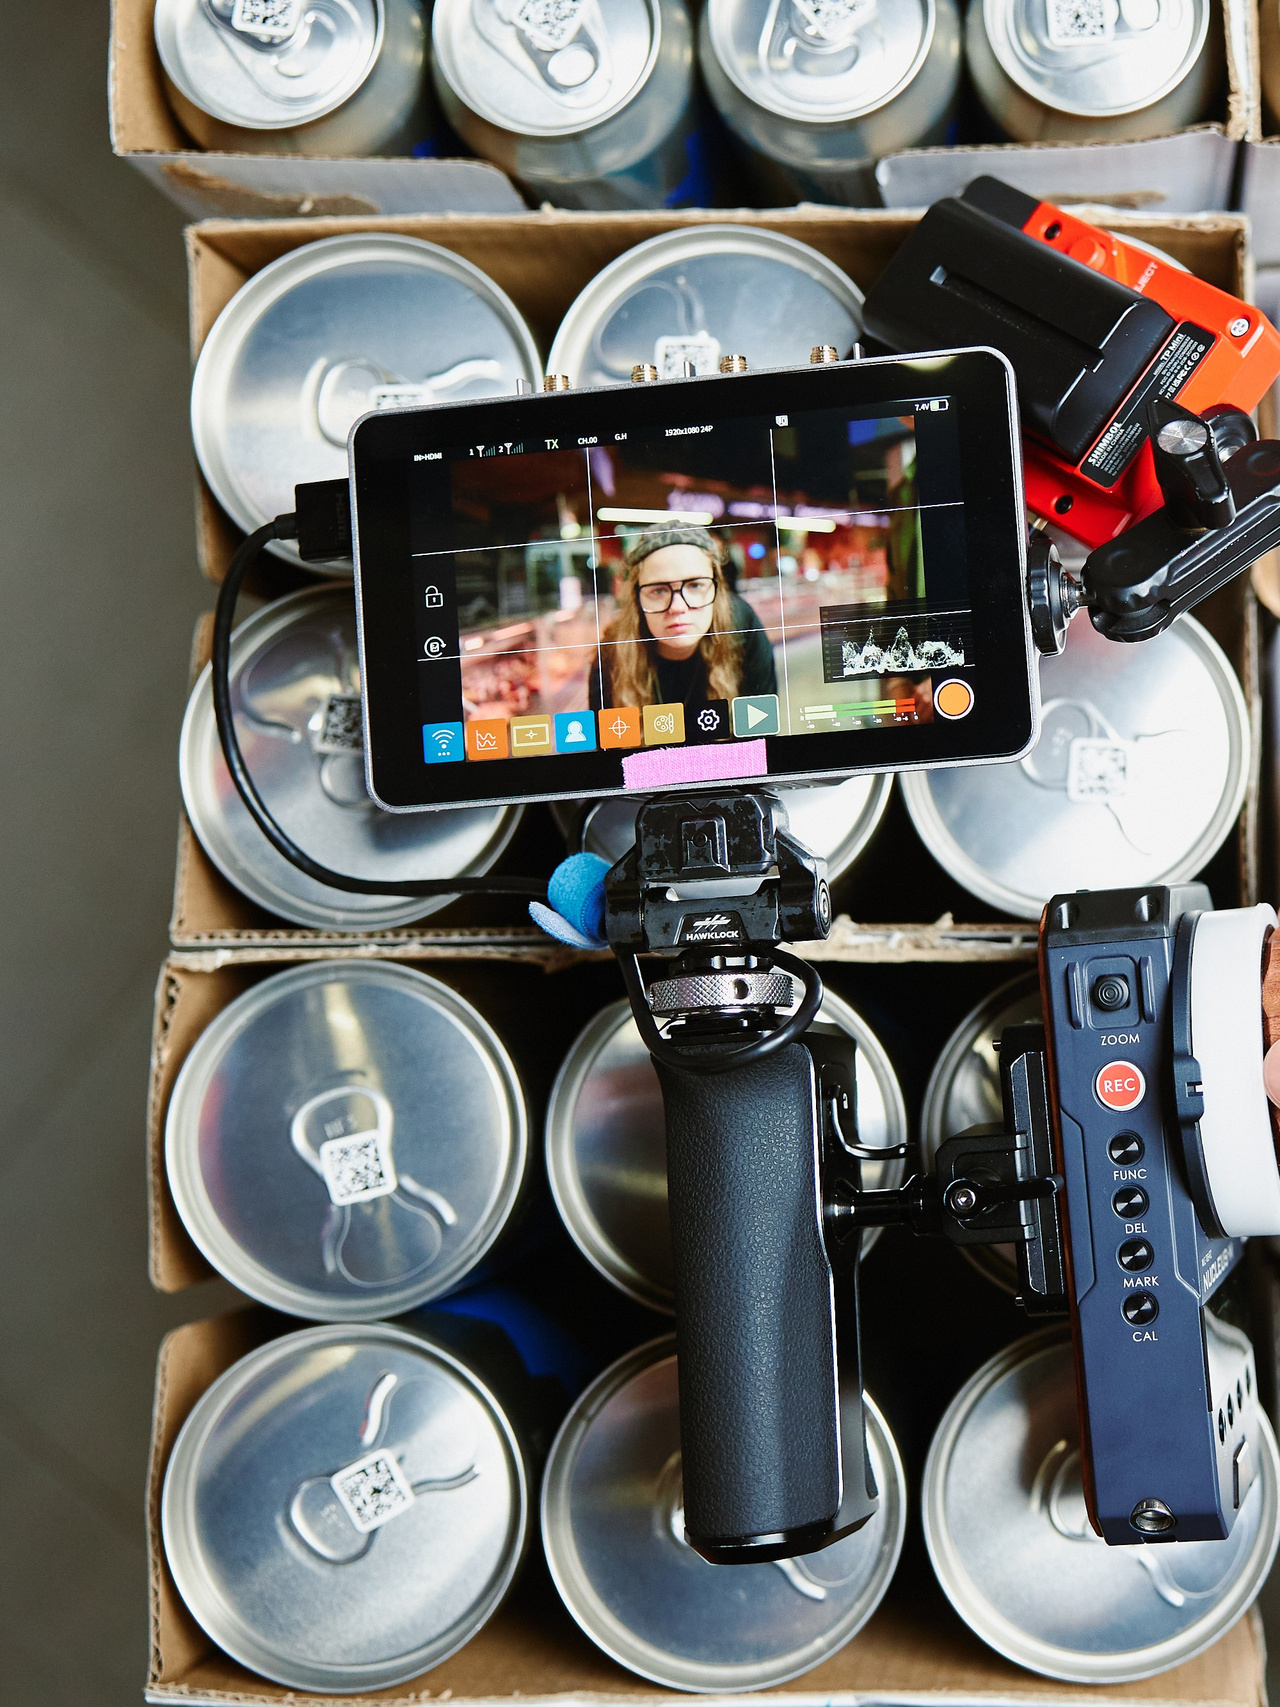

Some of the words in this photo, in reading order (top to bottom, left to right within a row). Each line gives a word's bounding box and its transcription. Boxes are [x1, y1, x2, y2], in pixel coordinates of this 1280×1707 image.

[1133, 261, 1158, 293] EJECT
[1160, 348, 1172, 362] TP
[1168, 333, 1184, 350] Mini
[914, 402, 930, 411] 7.4V
[665, 426, 700, 436] 1920x1080
[700, 425, 713, 434] 24P
[545, 439, 559, 450] TX
[578, 436, 598, 445] CH.00
[1087, 421, 1122, 465] SHIMBOL
[1094, 450, 1108, 468] MADE
[1110, 427, 1124, 446] CHINA
[686, 930, 739, 940] HAWKLOCK
[1101, 1034, 1140, 1046] ZOOM
[1104, 1078, 1136, 1093] REC
[1113, 1168, 1148, 1180] FUNC
[1125, 1222, 1147, 1234] DEL
[1123, 1276, 1159, 1288] MARK
[1132, 1331, 1158, 1342] CAL
